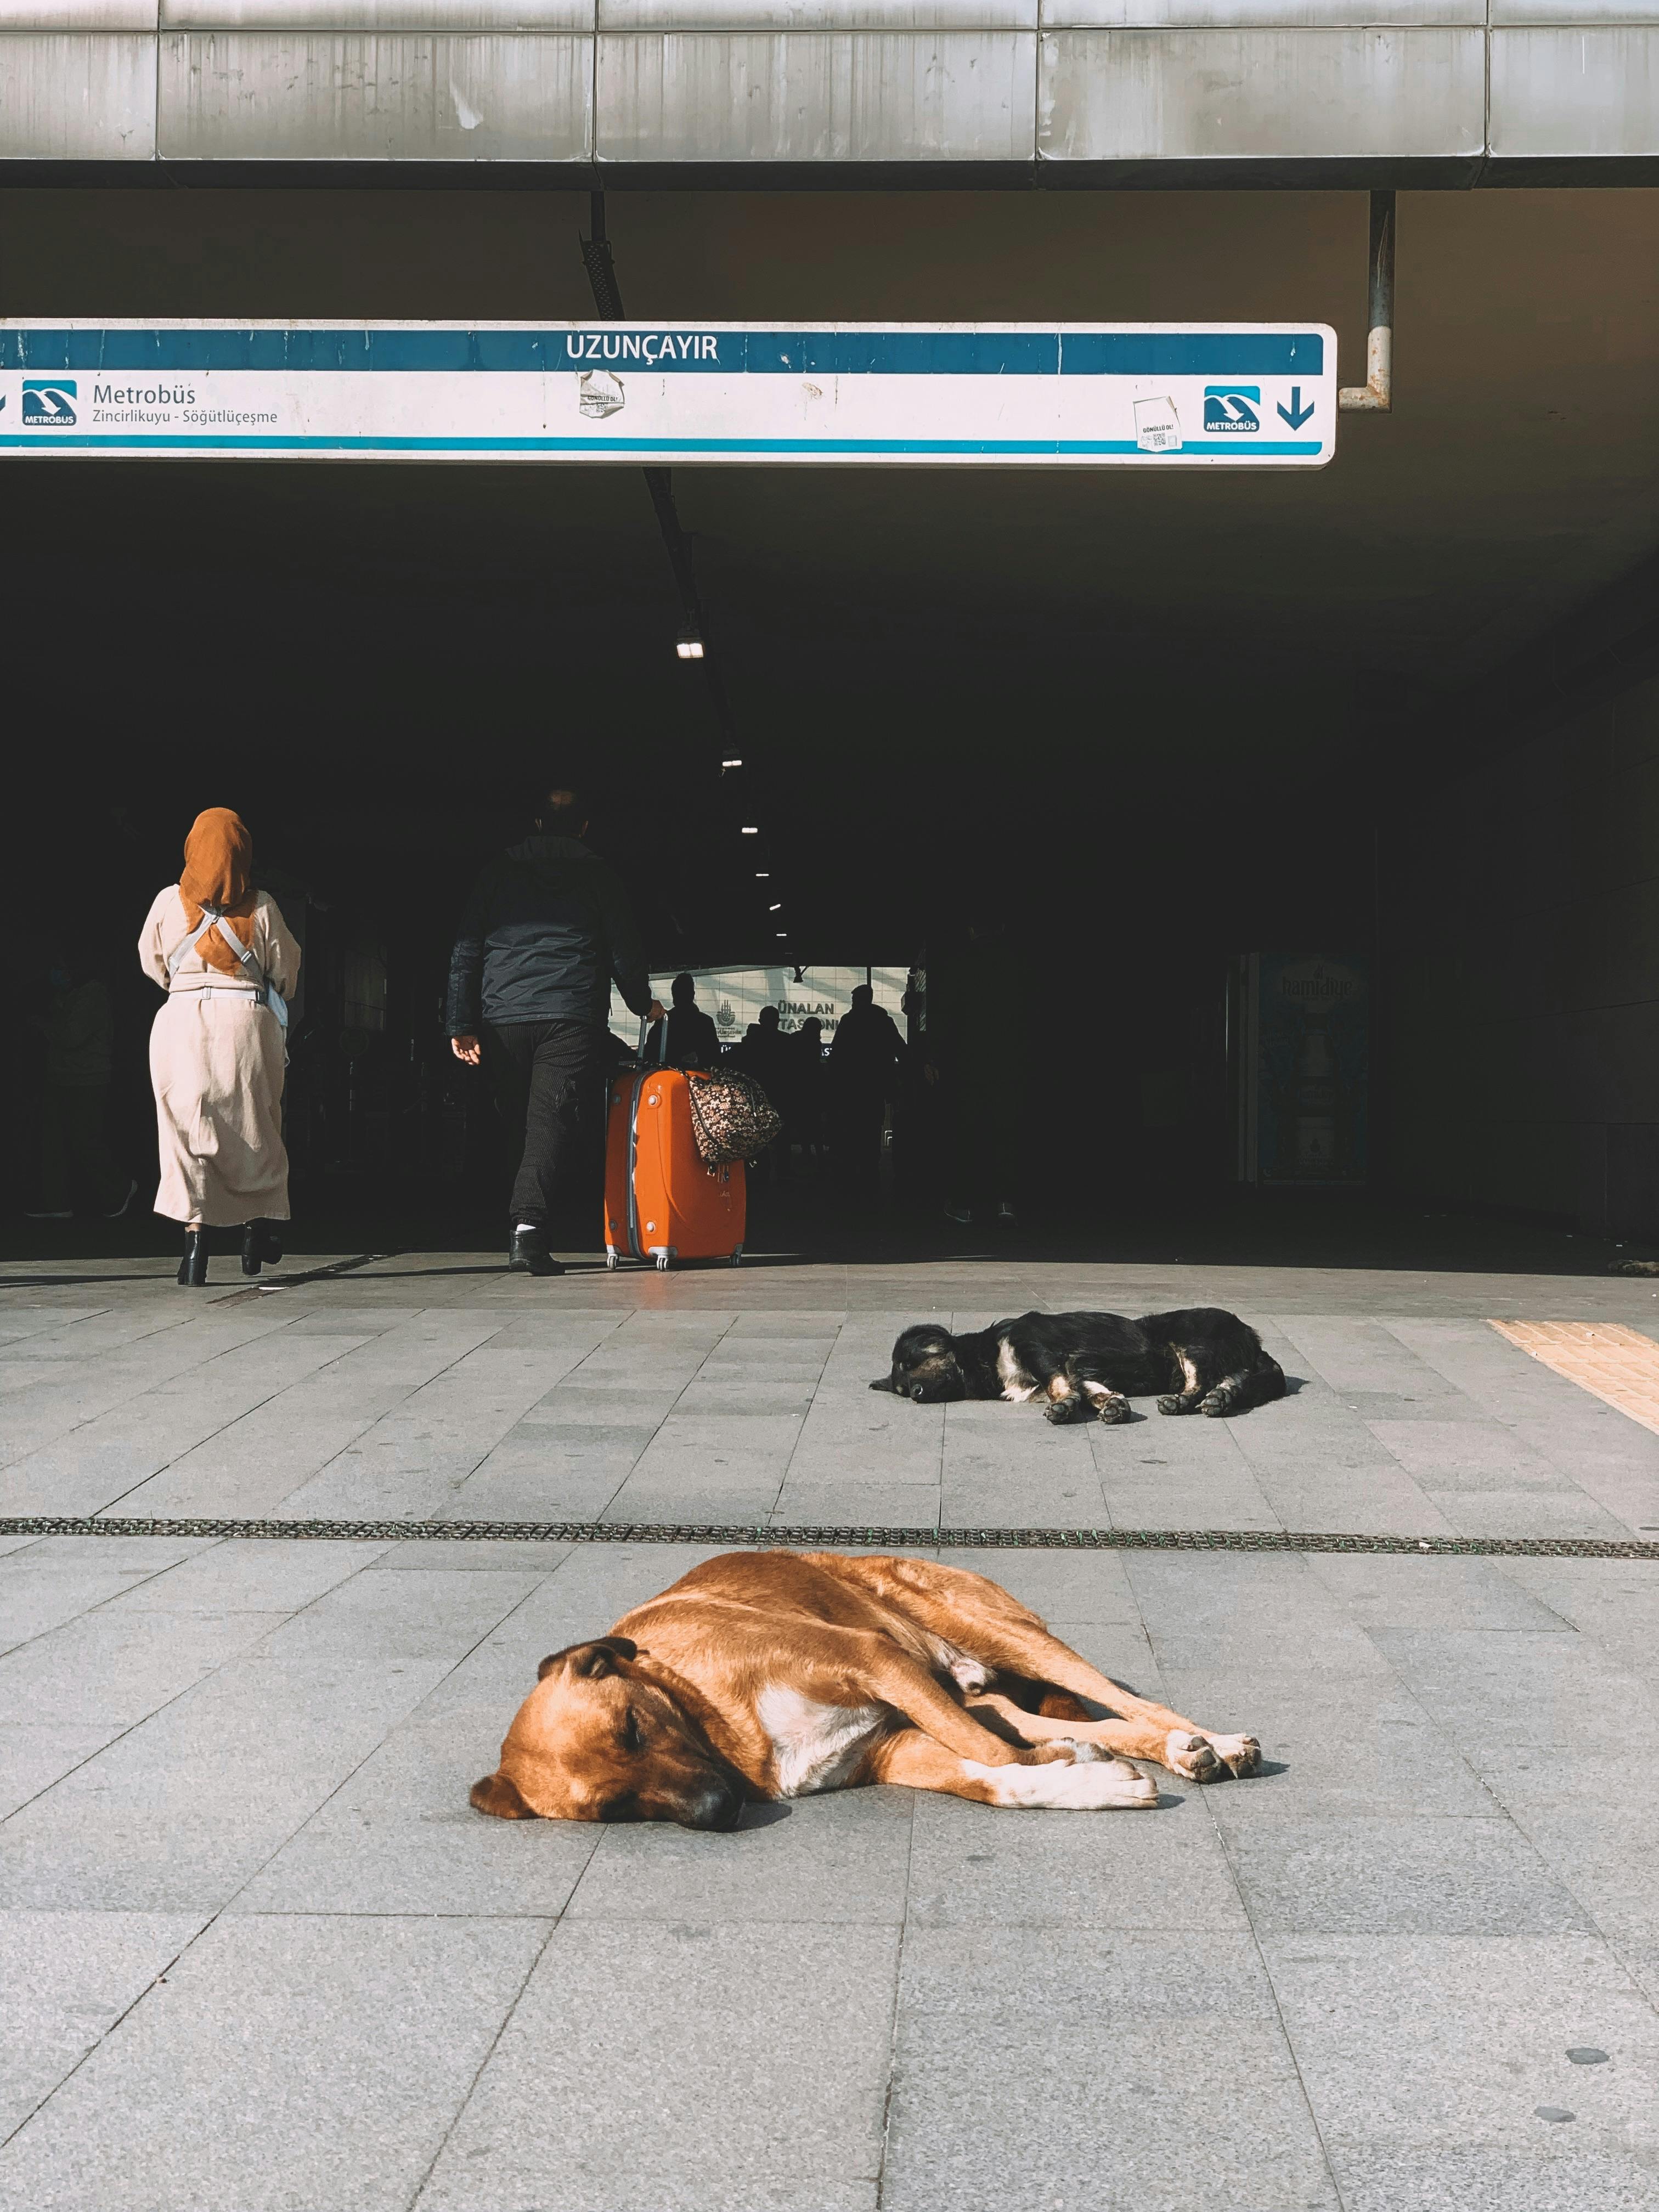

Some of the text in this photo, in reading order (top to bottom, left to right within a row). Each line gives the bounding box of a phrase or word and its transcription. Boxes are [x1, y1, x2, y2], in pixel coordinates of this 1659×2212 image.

[567, 335, 718, 365] UZUNÇAYIR
[93, 384, 196, 404] Metrobüs
[92, 409, 171, 426] Zincirlikuyu
[183, 409, 278, 426] Söğütlüçeşme
[1206, 420, 1257, 431] METROBÜS
[778, 1000, 834, 1014] ÜNALAN
